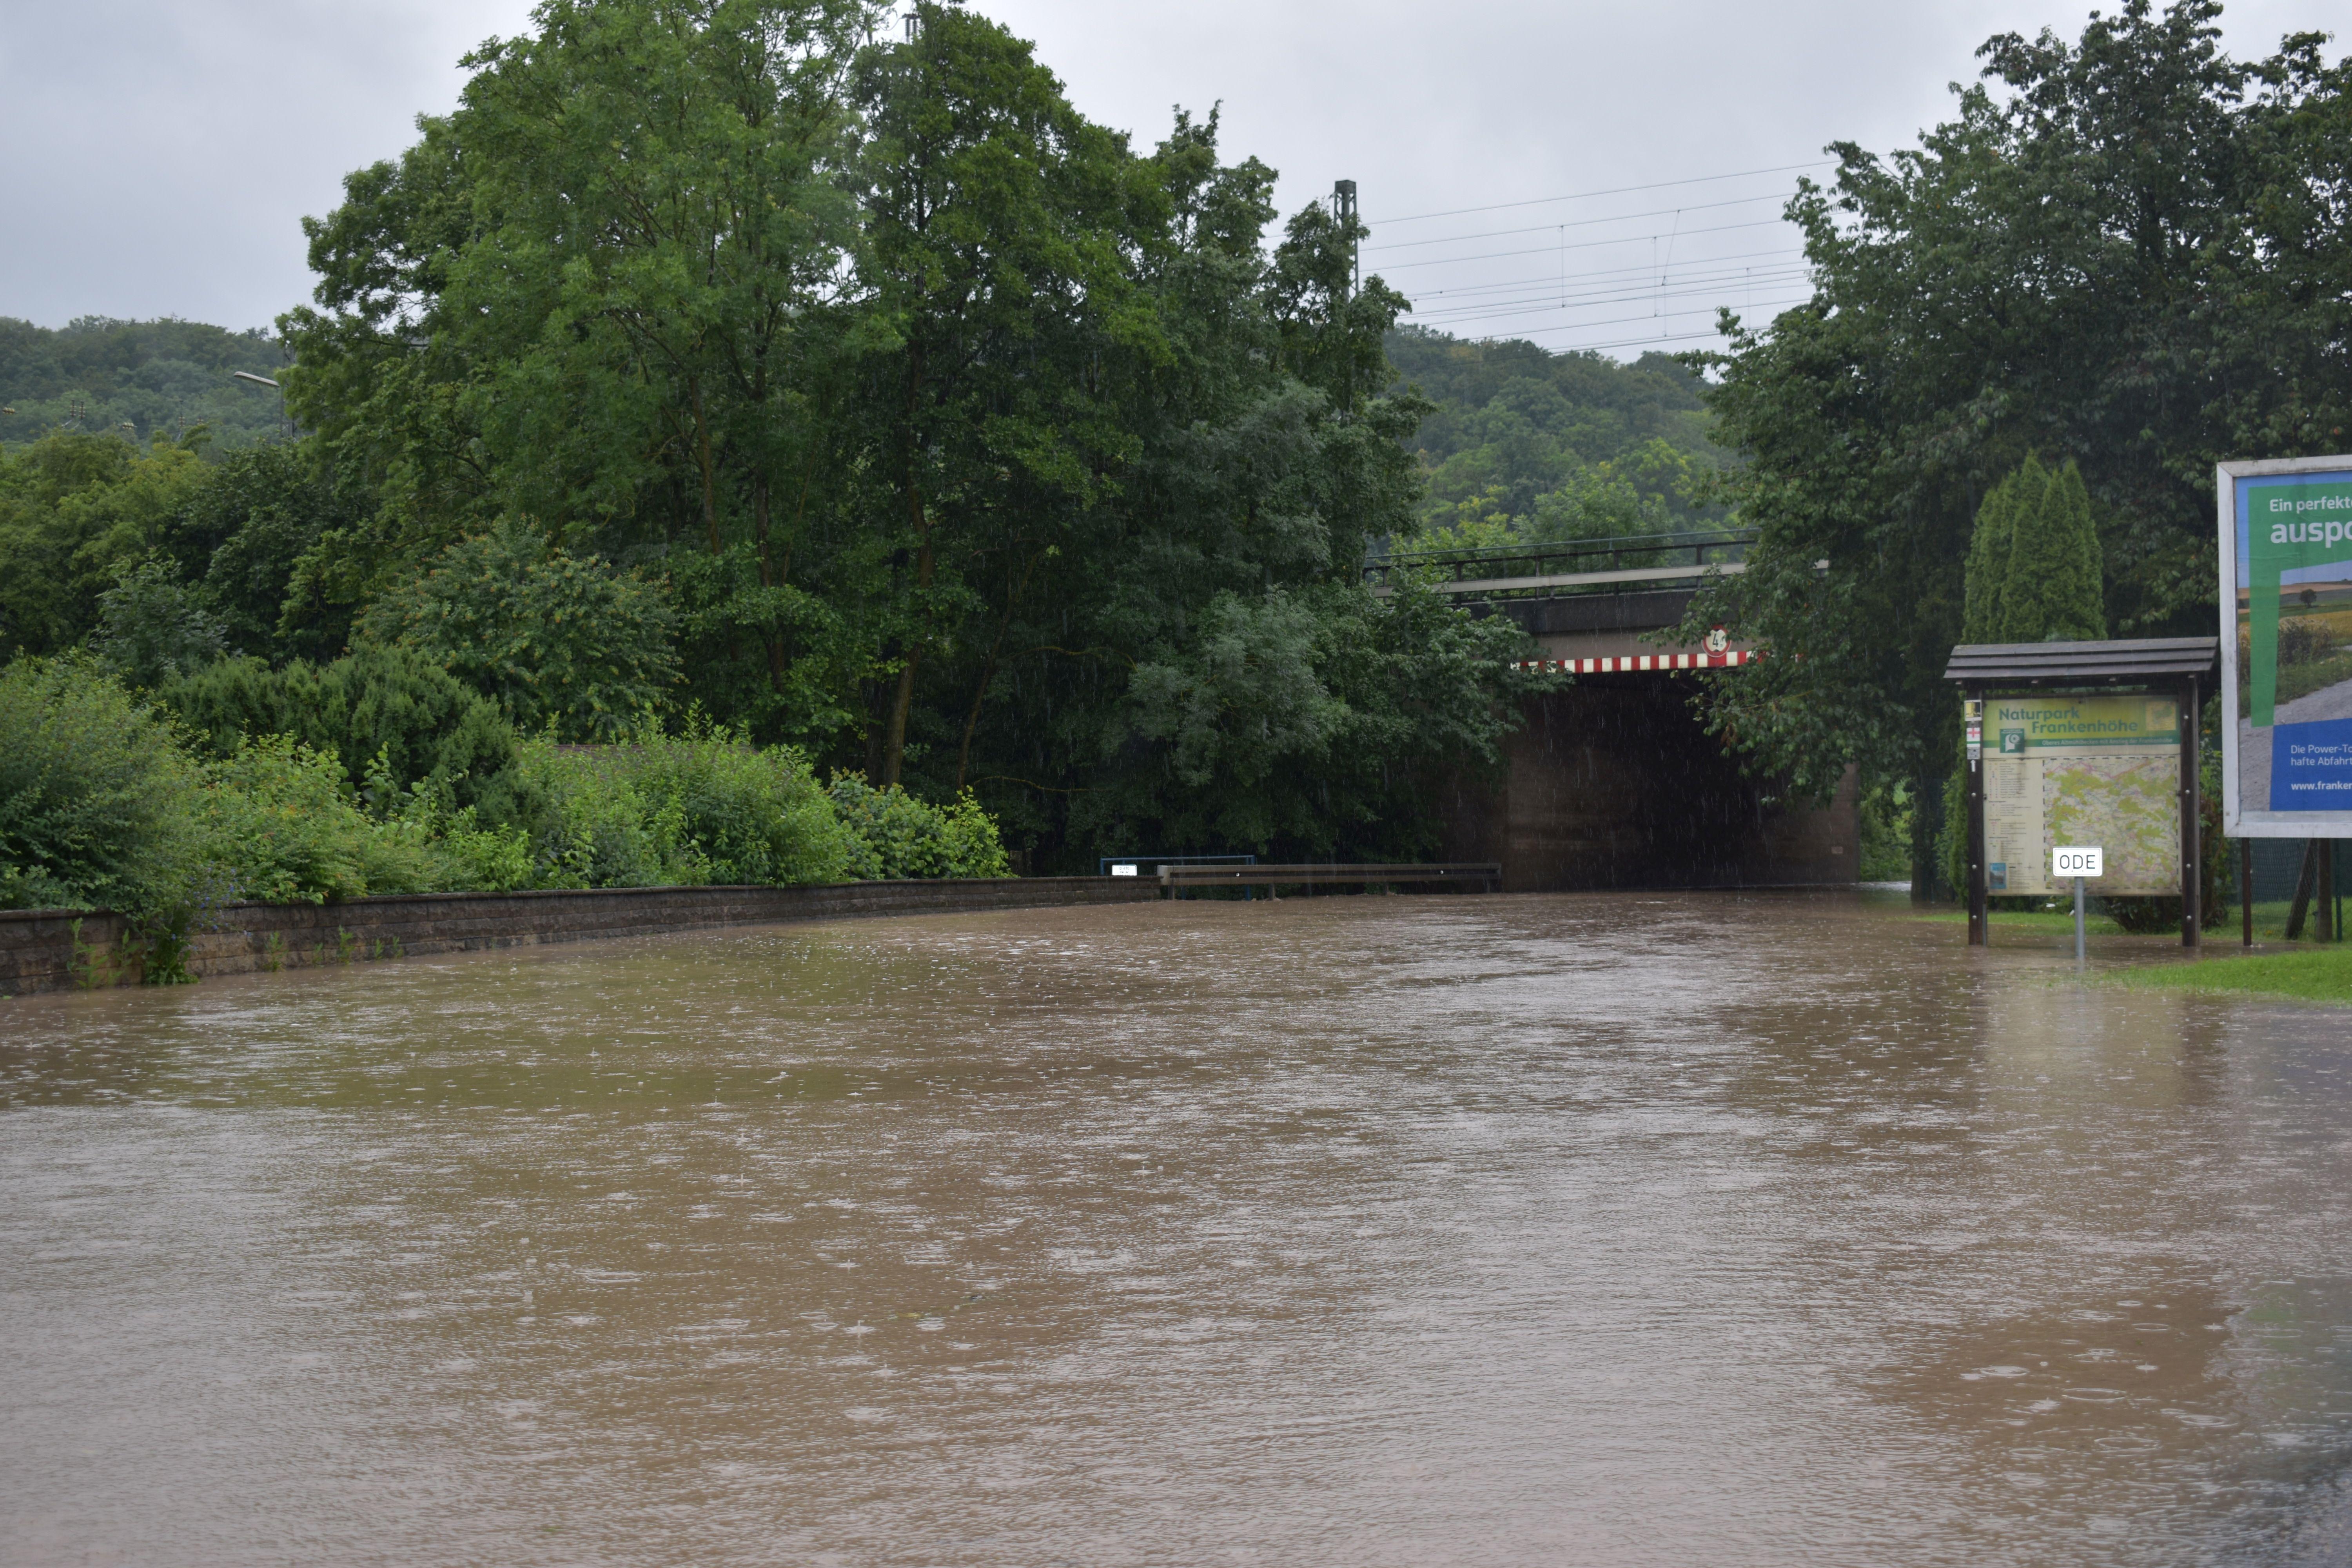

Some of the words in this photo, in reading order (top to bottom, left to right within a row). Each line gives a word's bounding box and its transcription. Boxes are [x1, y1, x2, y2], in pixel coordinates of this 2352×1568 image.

[2270, 498, 2292, 512] Ein
[2296, 495, 2352, 514] perfekt
[1999, 707, 2079, 721] Naturpark
[2032, 720, 2138, 733] Frankenhöhe
[2291, 745, 2305, 754] Die
[2291, 757, 2315, 766] hafte
[2060, 855, 2096, 869] ODE
